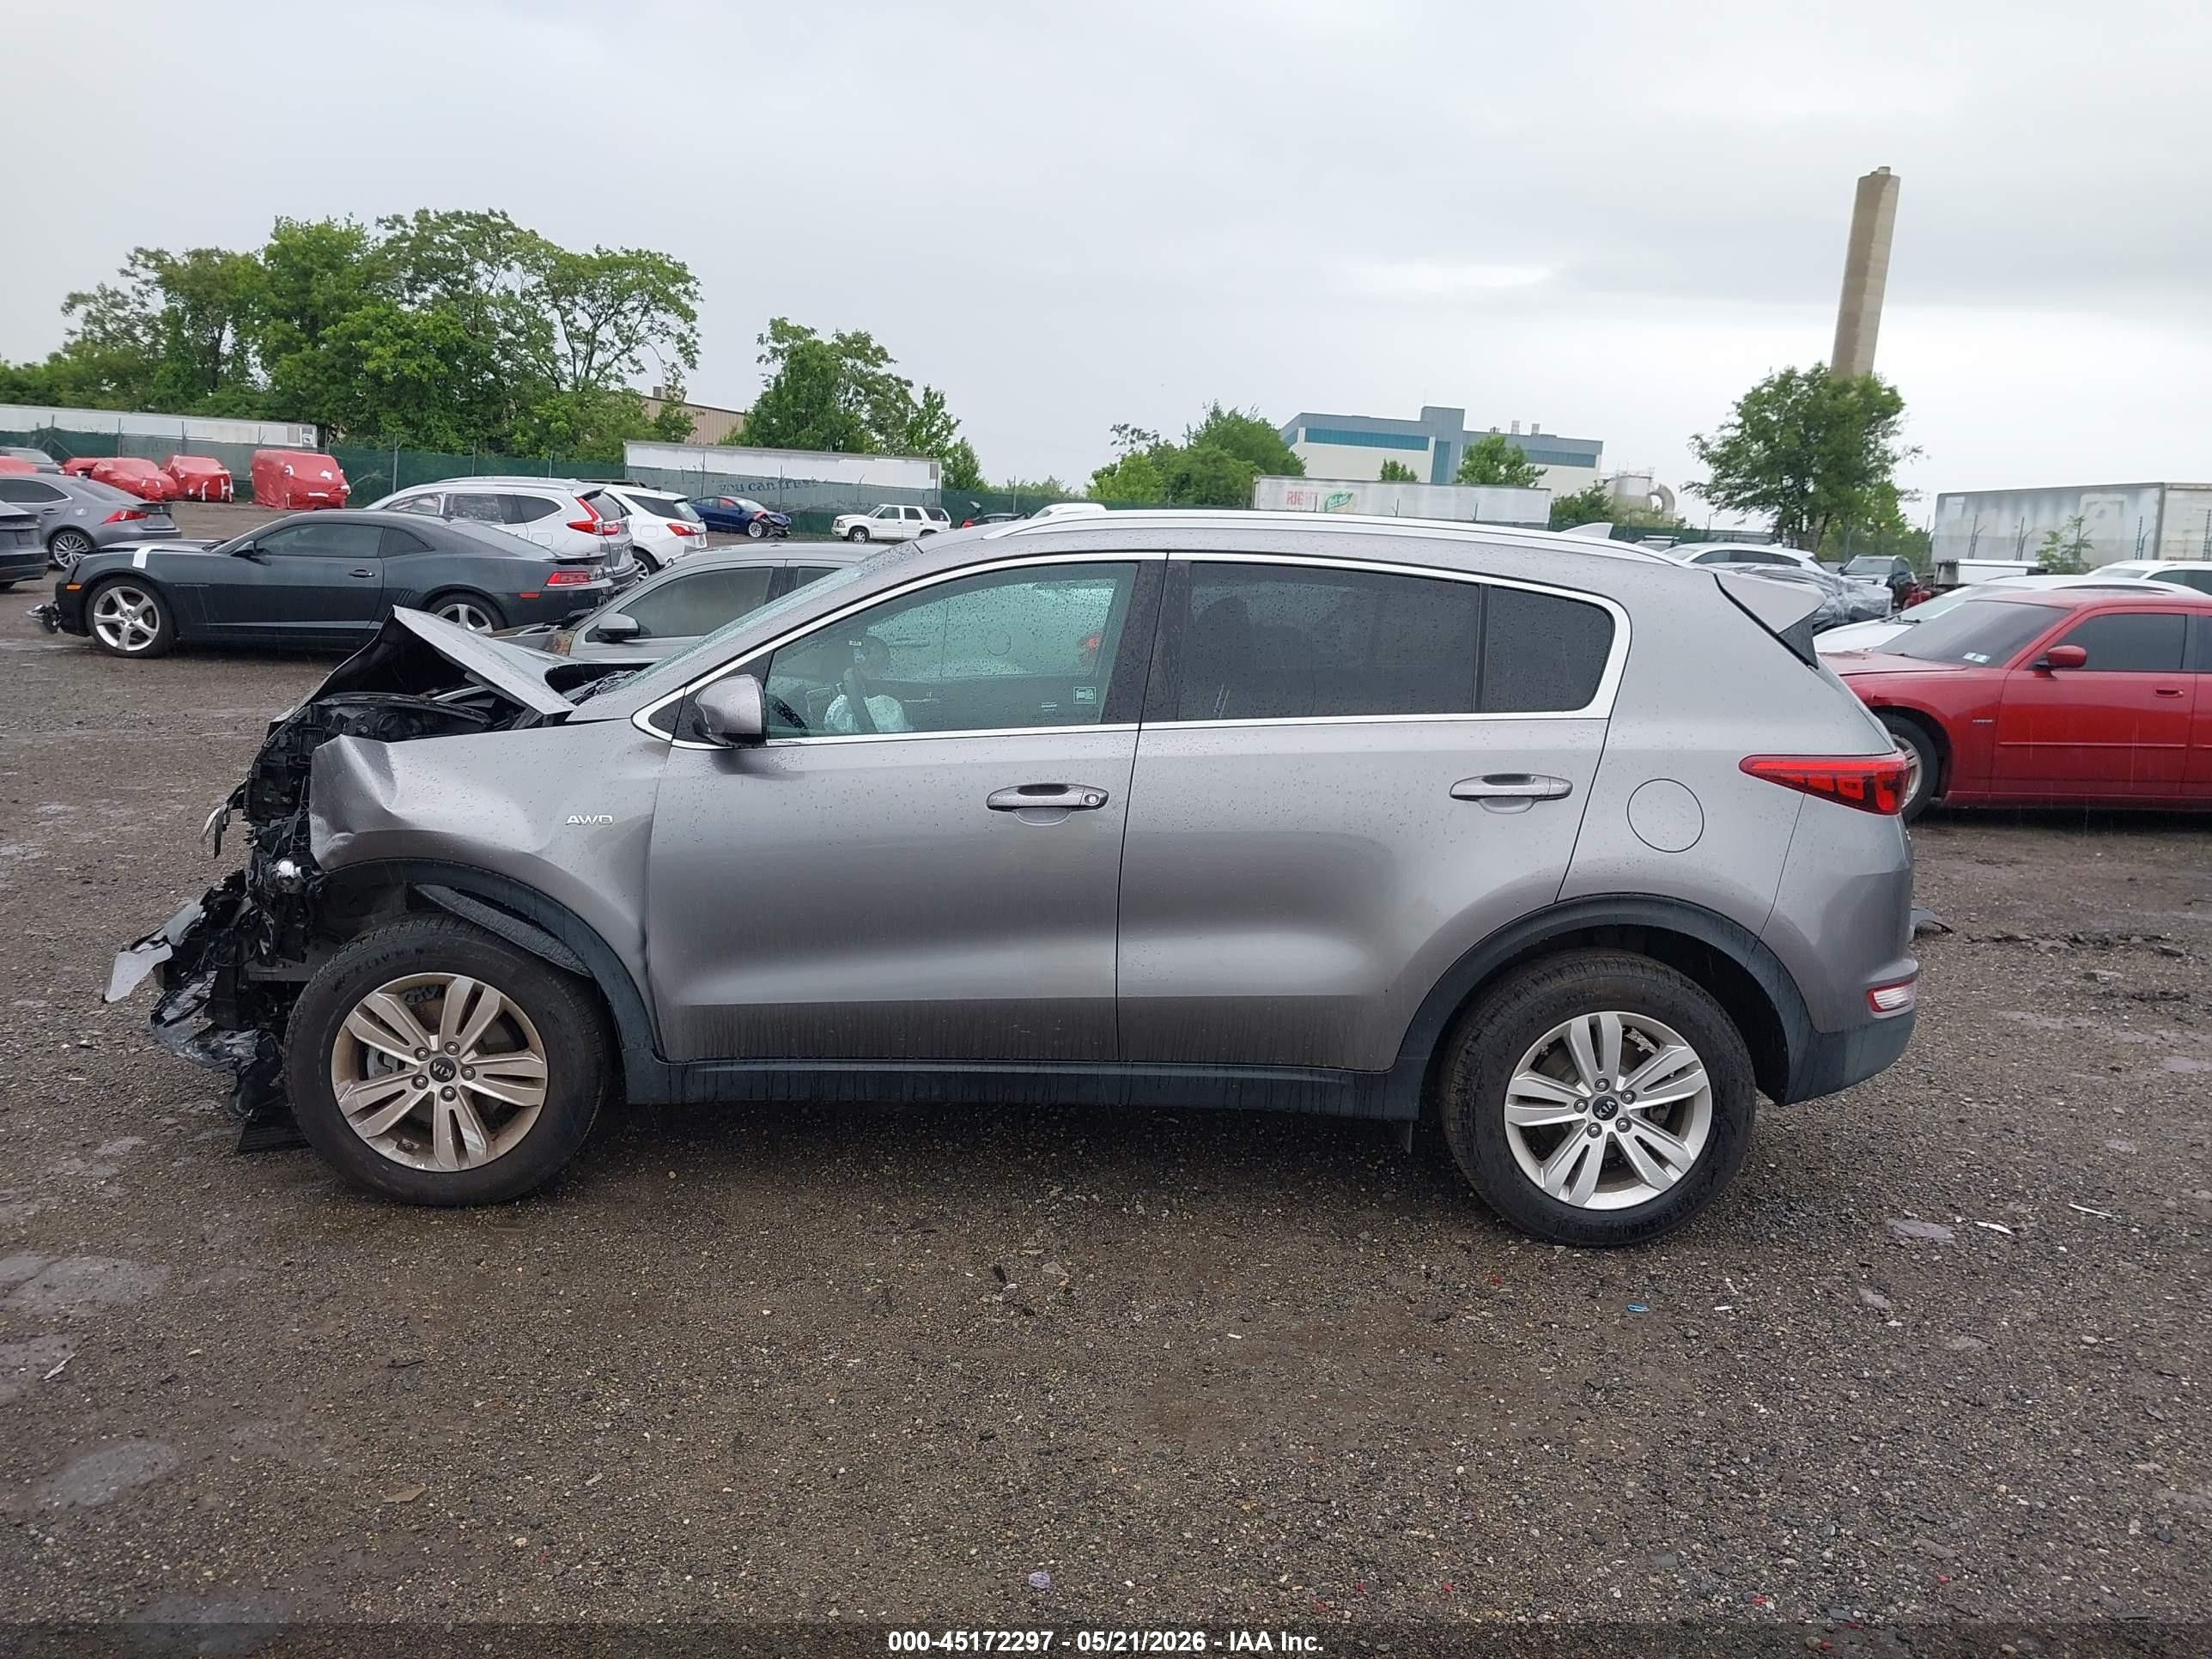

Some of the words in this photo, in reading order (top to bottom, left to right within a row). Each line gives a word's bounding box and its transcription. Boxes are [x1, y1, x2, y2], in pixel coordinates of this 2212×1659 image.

[748, 482, 775, 492] can
[566, 814, 613, 825] AWD
[433, 1062, 453, 1079] KIA
[1596, 1100, 1615, 1118] KIA
